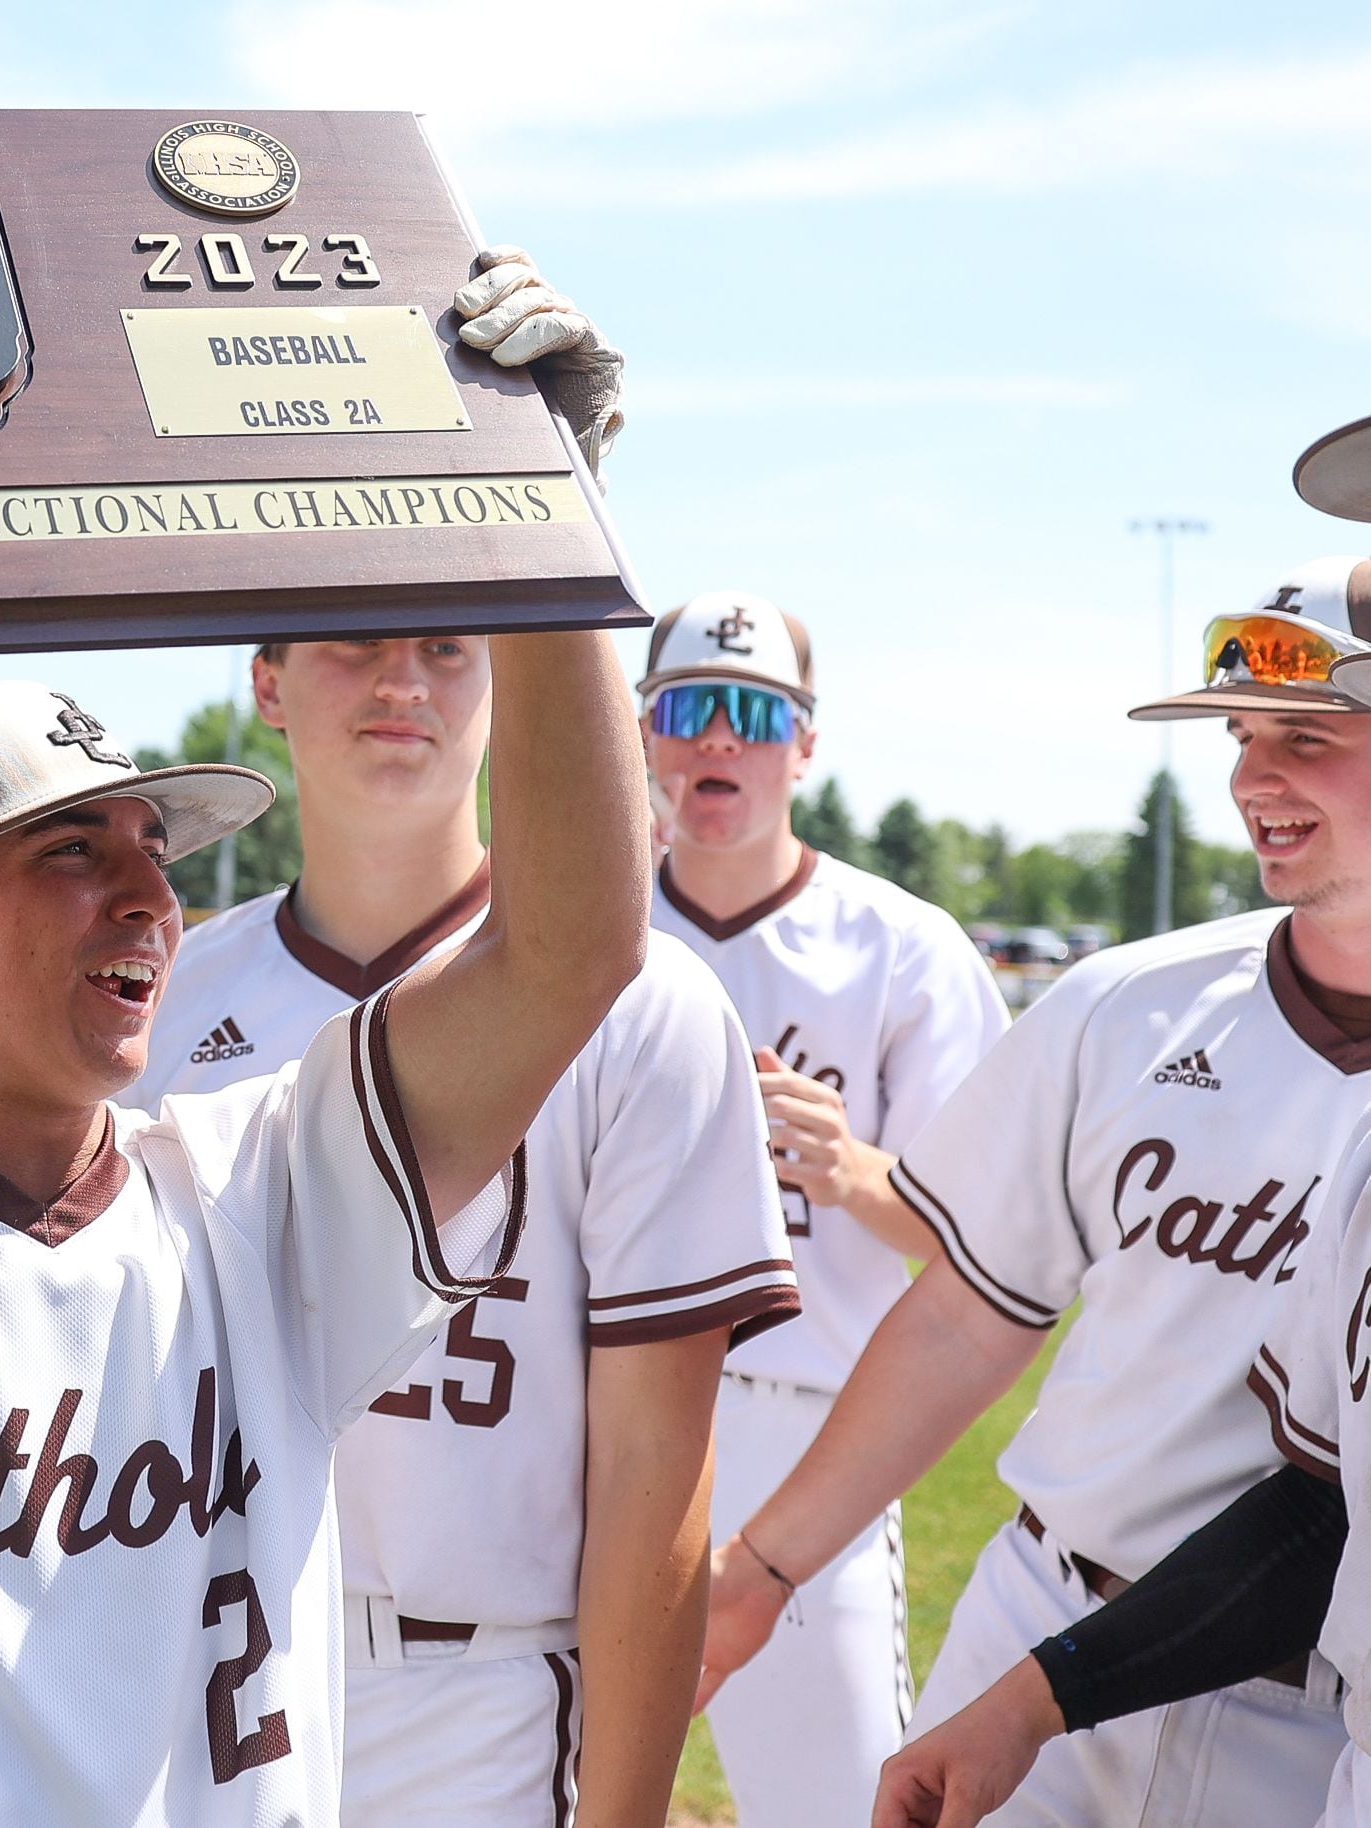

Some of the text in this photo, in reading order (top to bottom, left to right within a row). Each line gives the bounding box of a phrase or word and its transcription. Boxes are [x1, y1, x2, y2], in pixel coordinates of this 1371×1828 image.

[159, 123, 294, 178] ILLINOIS HIGH SCHOOL
[177, 182, 290, 208] ASSOCIATION
[136, 233, 381, 290] 2023
[207, 334, 367, 366] BASEBALL
[239, 399, 383, 427] CLASS 2A
[253, 484, 552, 529] CHAMPIONS
[190, 1043, 254, 1063] adidas
[1154, 1069, 1222, 1091] adidas
[202, 1571, 293, 1786] 2
